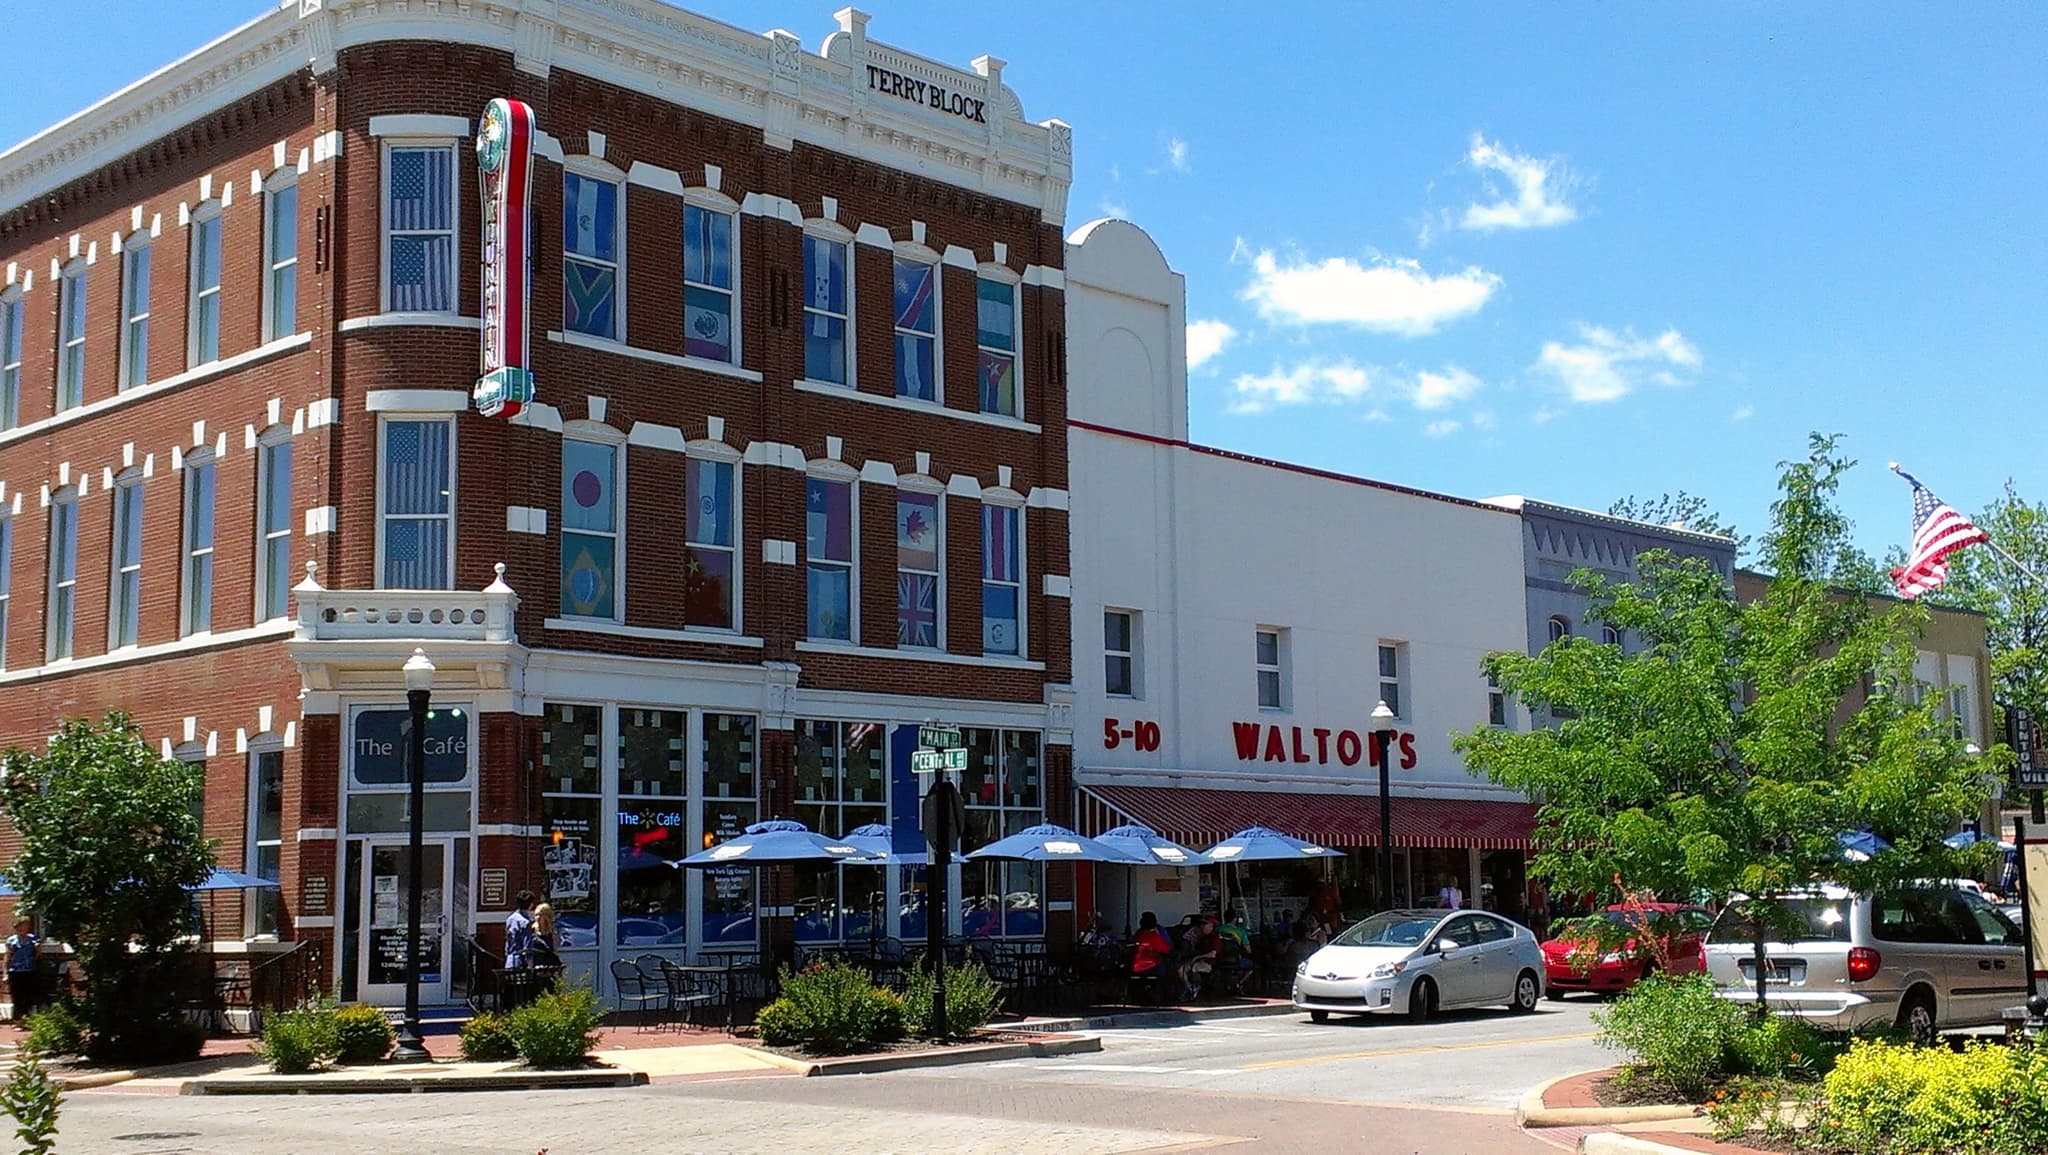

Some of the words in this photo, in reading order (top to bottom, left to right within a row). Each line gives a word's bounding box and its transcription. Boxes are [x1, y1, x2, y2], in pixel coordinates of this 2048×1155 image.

[866, 64, 927, 104] TERRY
[929, 83, 986, 124] BLOCK
[926, 730, 950, 748] MAIN
[1103, 717, 1161, 752] 5-10
[356, 738, 393, 756] The
[422, 735, 467, 755] Café
[920, 751, 956, 769] CENTRAL
[617, 811, 640, 825] The
[656, 811, 681, 826] Café
